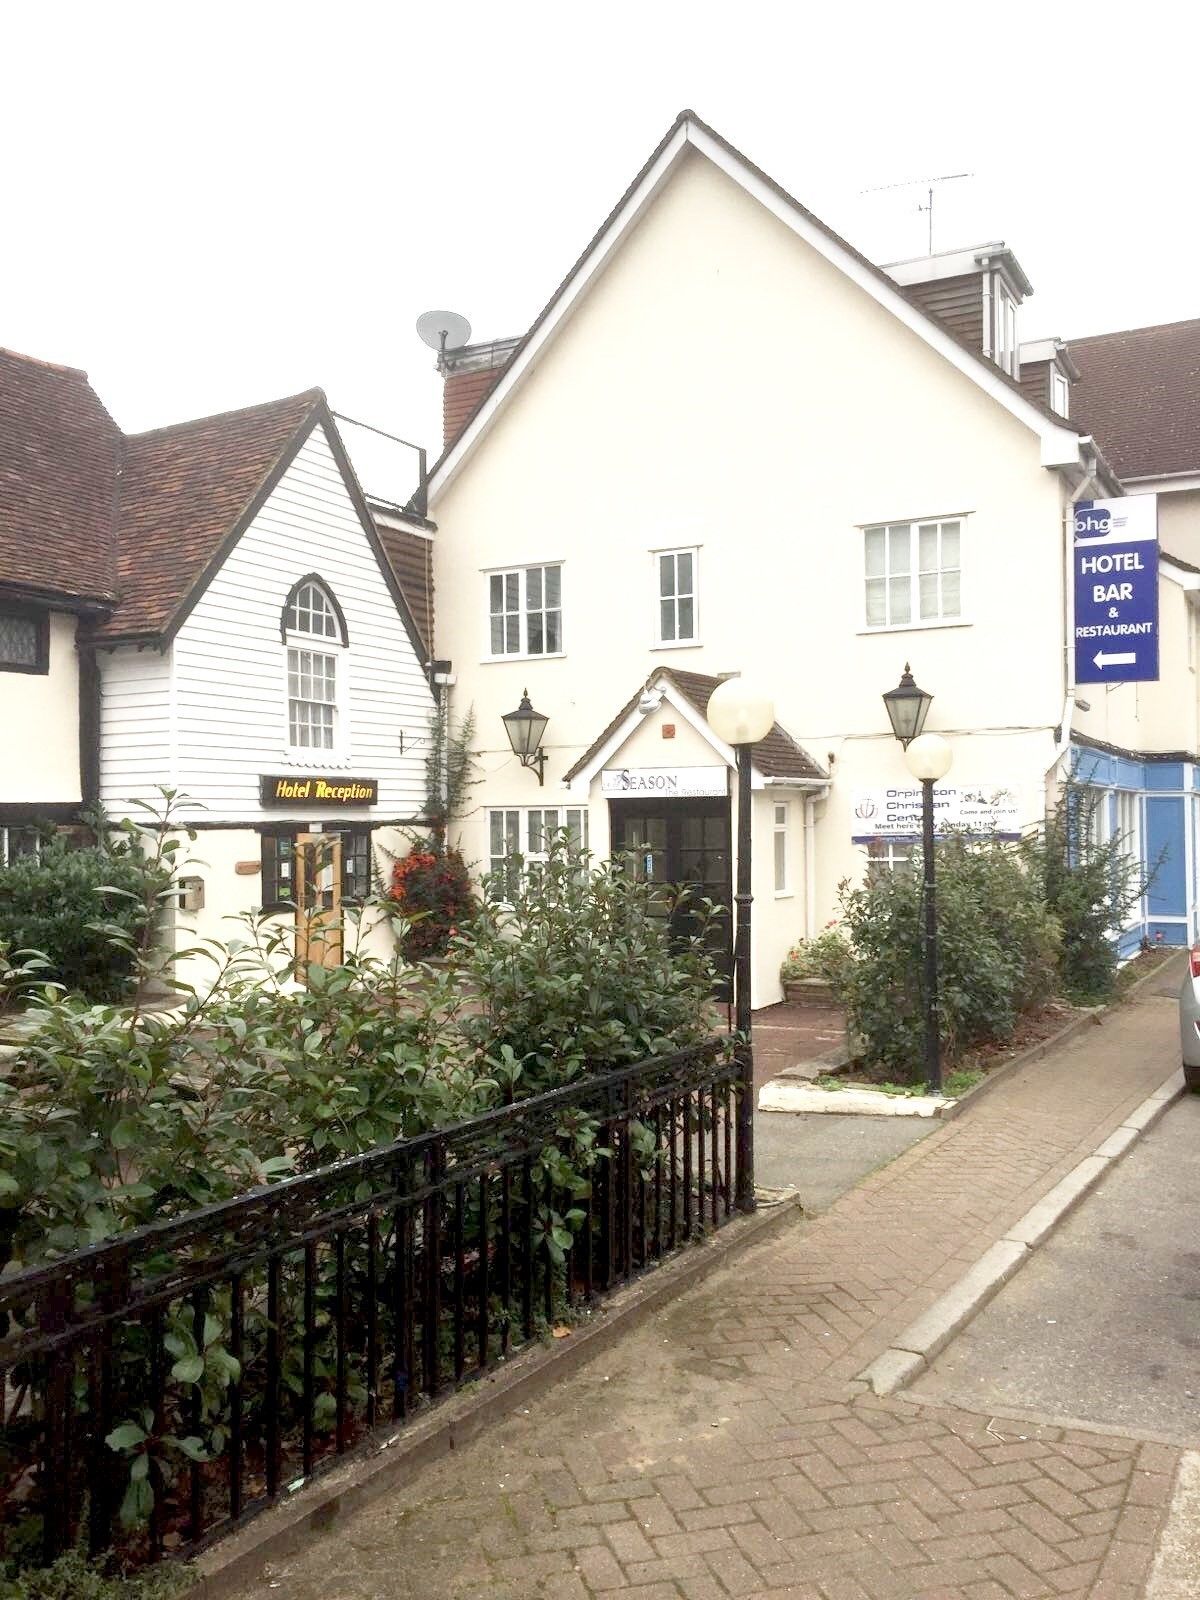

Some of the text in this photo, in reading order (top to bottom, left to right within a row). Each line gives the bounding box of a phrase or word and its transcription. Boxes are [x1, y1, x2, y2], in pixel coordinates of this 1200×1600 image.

[1081, 552, 1144, 575] HOTEL
[1093, 582, 1133, 603] BAR
[1108, 606, 1119, 619] &
[1075, 622, 1153, 638] RESTAURANT
[621, 769, 677, 790] SEASON
[276, 780, 373, 802] Hotel Reception
[886, 789, 957, 799] Orpinton
[886, 801, 950, 810] Chrisan
